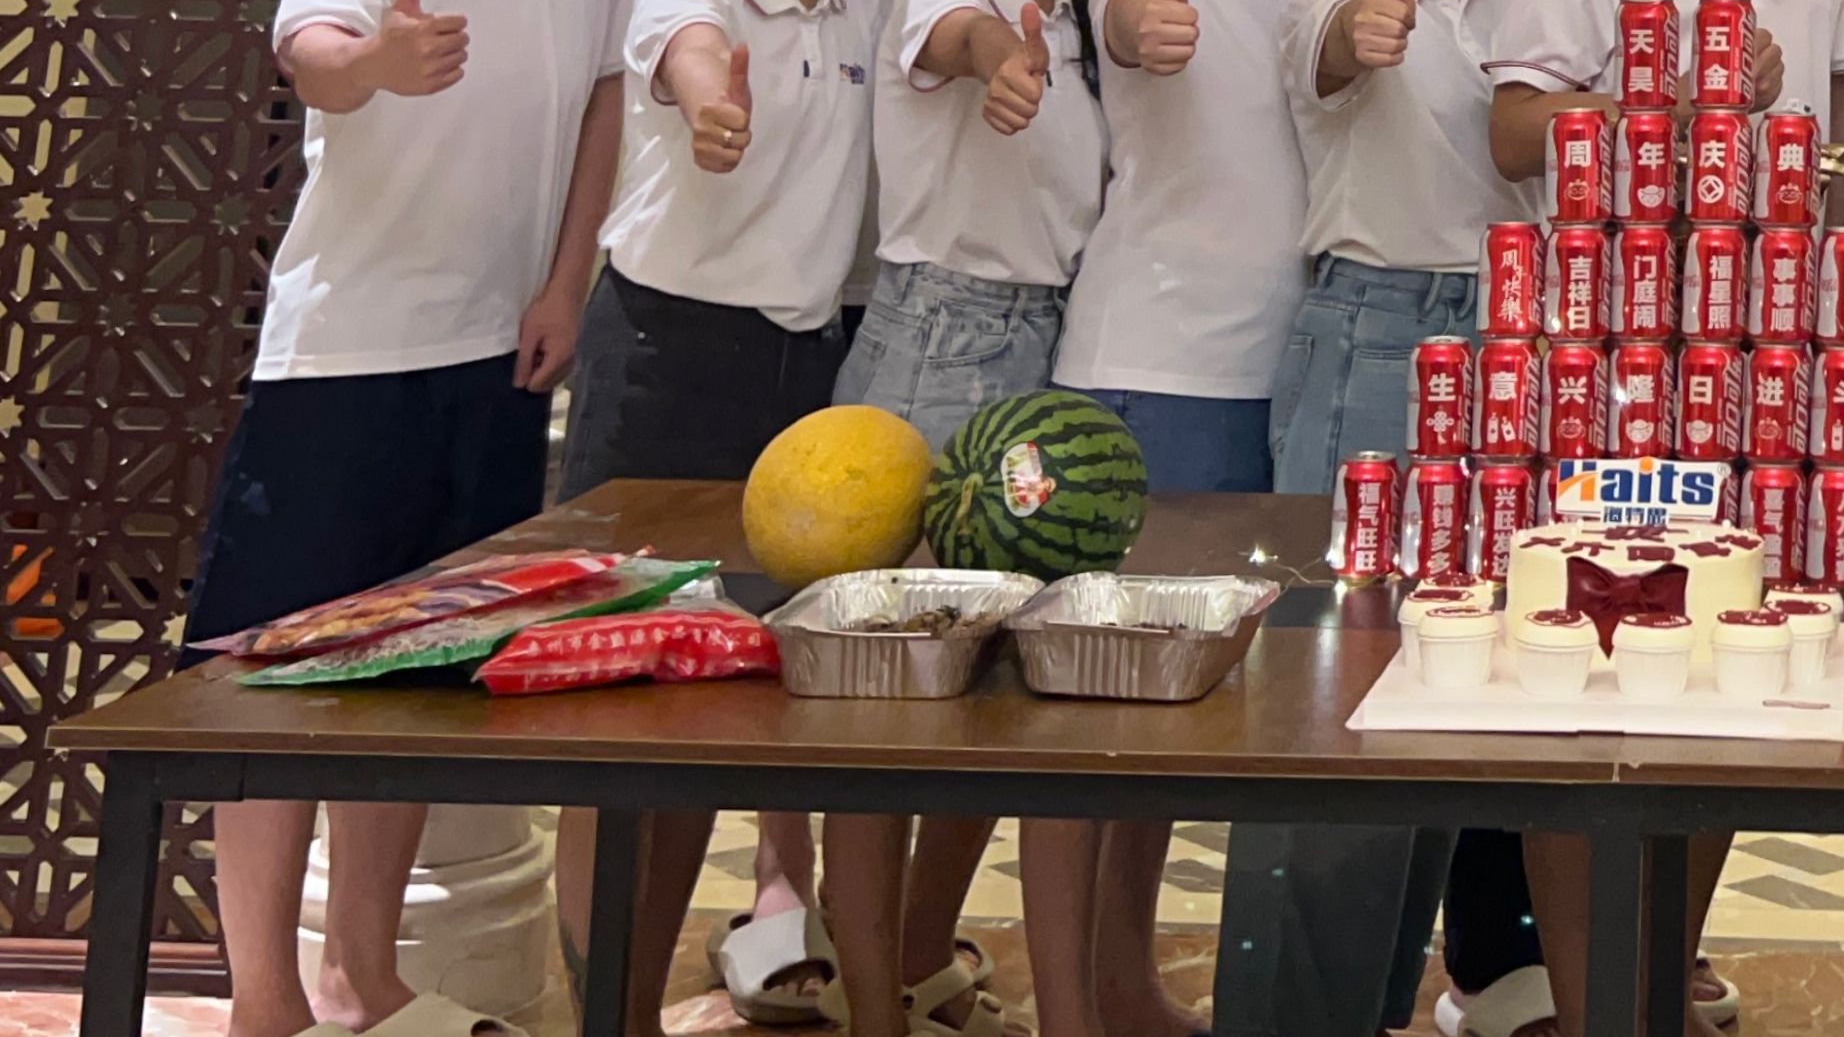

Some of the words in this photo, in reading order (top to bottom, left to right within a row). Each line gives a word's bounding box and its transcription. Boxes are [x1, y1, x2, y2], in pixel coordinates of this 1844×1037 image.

[1628, 28, 1655, 93] 天昊
[1703, 26, 1730, 91] 五金
[1563, 140, 1592, 168] 周
[1636, 142, 1666, 170] 年
[1699, 140, 1727, 168] 庆
[1776, 143, 1805, 172] 典
[1566, 255, 1593, 331] 吉祥日
[1427, 372, 1457, 402] 生
[1488, 370, 1518, 401] 意
[1557, 375, 1587, 404] 兴
[1625, 373, 1655, 404] 隆
[1688, 375, 1713, 405] 日
[1756, 371, 1785, 406] 进
[1354, 481, 1382, 572] 福气旺旺
